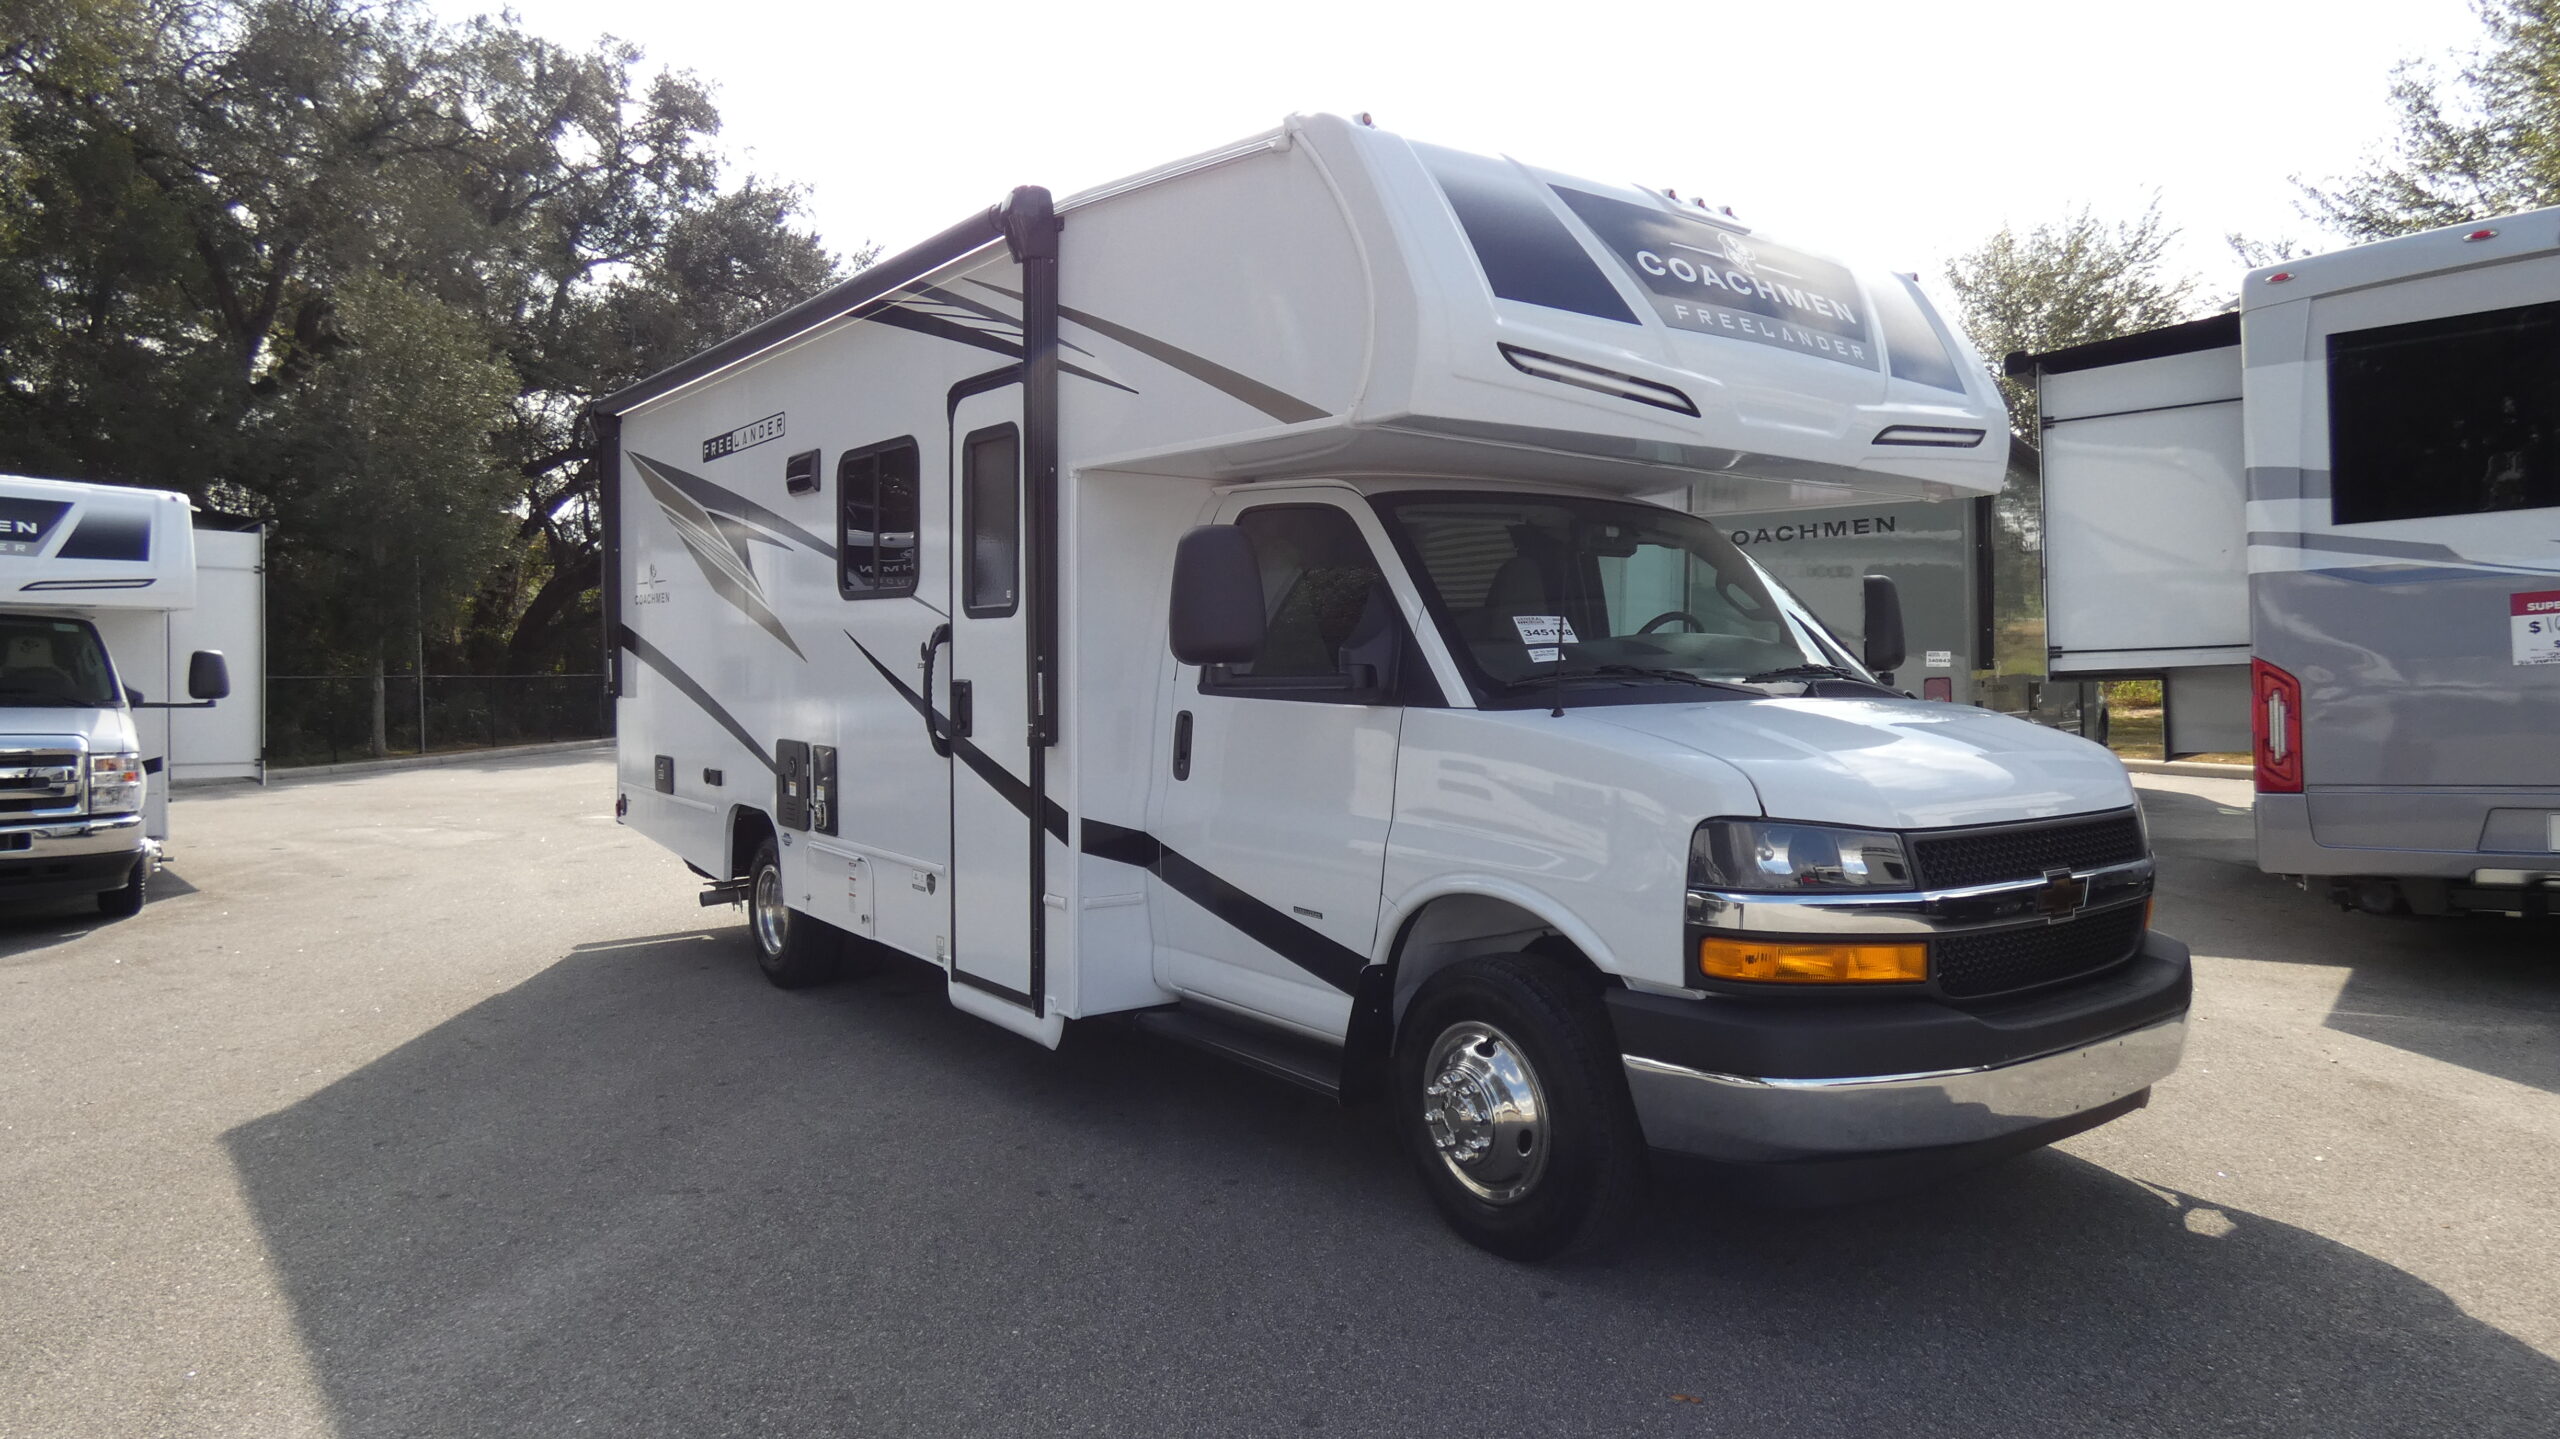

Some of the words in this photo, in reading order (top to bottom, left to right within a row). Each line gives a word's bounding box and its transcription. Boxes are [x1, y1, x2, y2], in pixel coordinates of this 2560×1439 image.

[1637, 250, 1857, 324] COACHMEN
[1675, 304, 1865, 360] FREELANDER
[1730, 516, 1896, 546] OACHMEN
